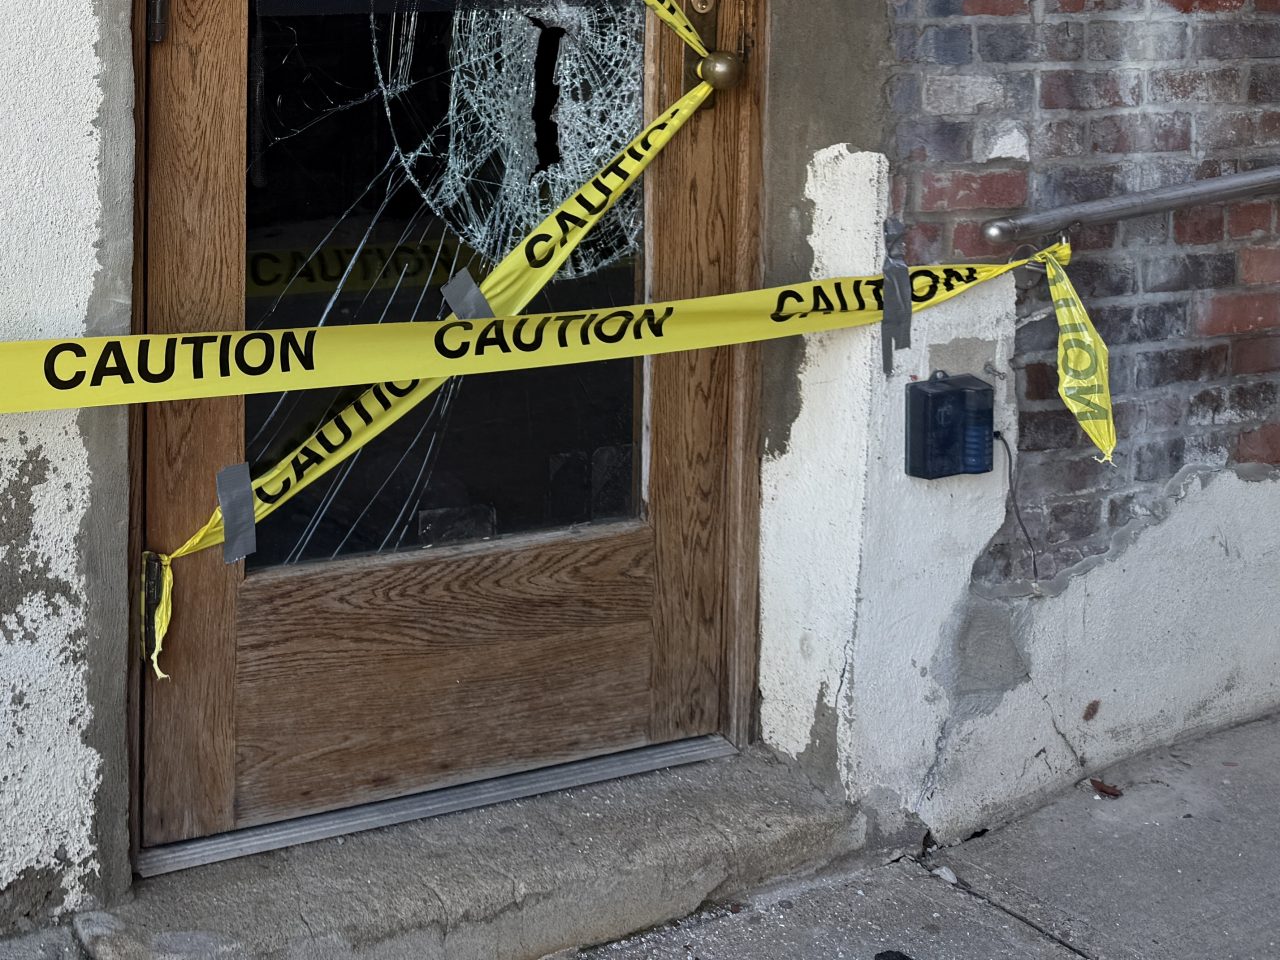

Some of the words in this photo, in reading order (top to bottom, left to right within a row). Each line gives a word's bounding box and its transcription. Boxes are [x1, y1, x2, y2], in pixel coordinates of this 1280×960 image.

[525, 108, 680, 269] CAUTIO
[43, 329, 317, 391] CAUTION
[433, 306, 674, 360] CAUTION
[770, 267, 978, 323] CAUTON
[255, 378, 420, 505] CAUTIO
